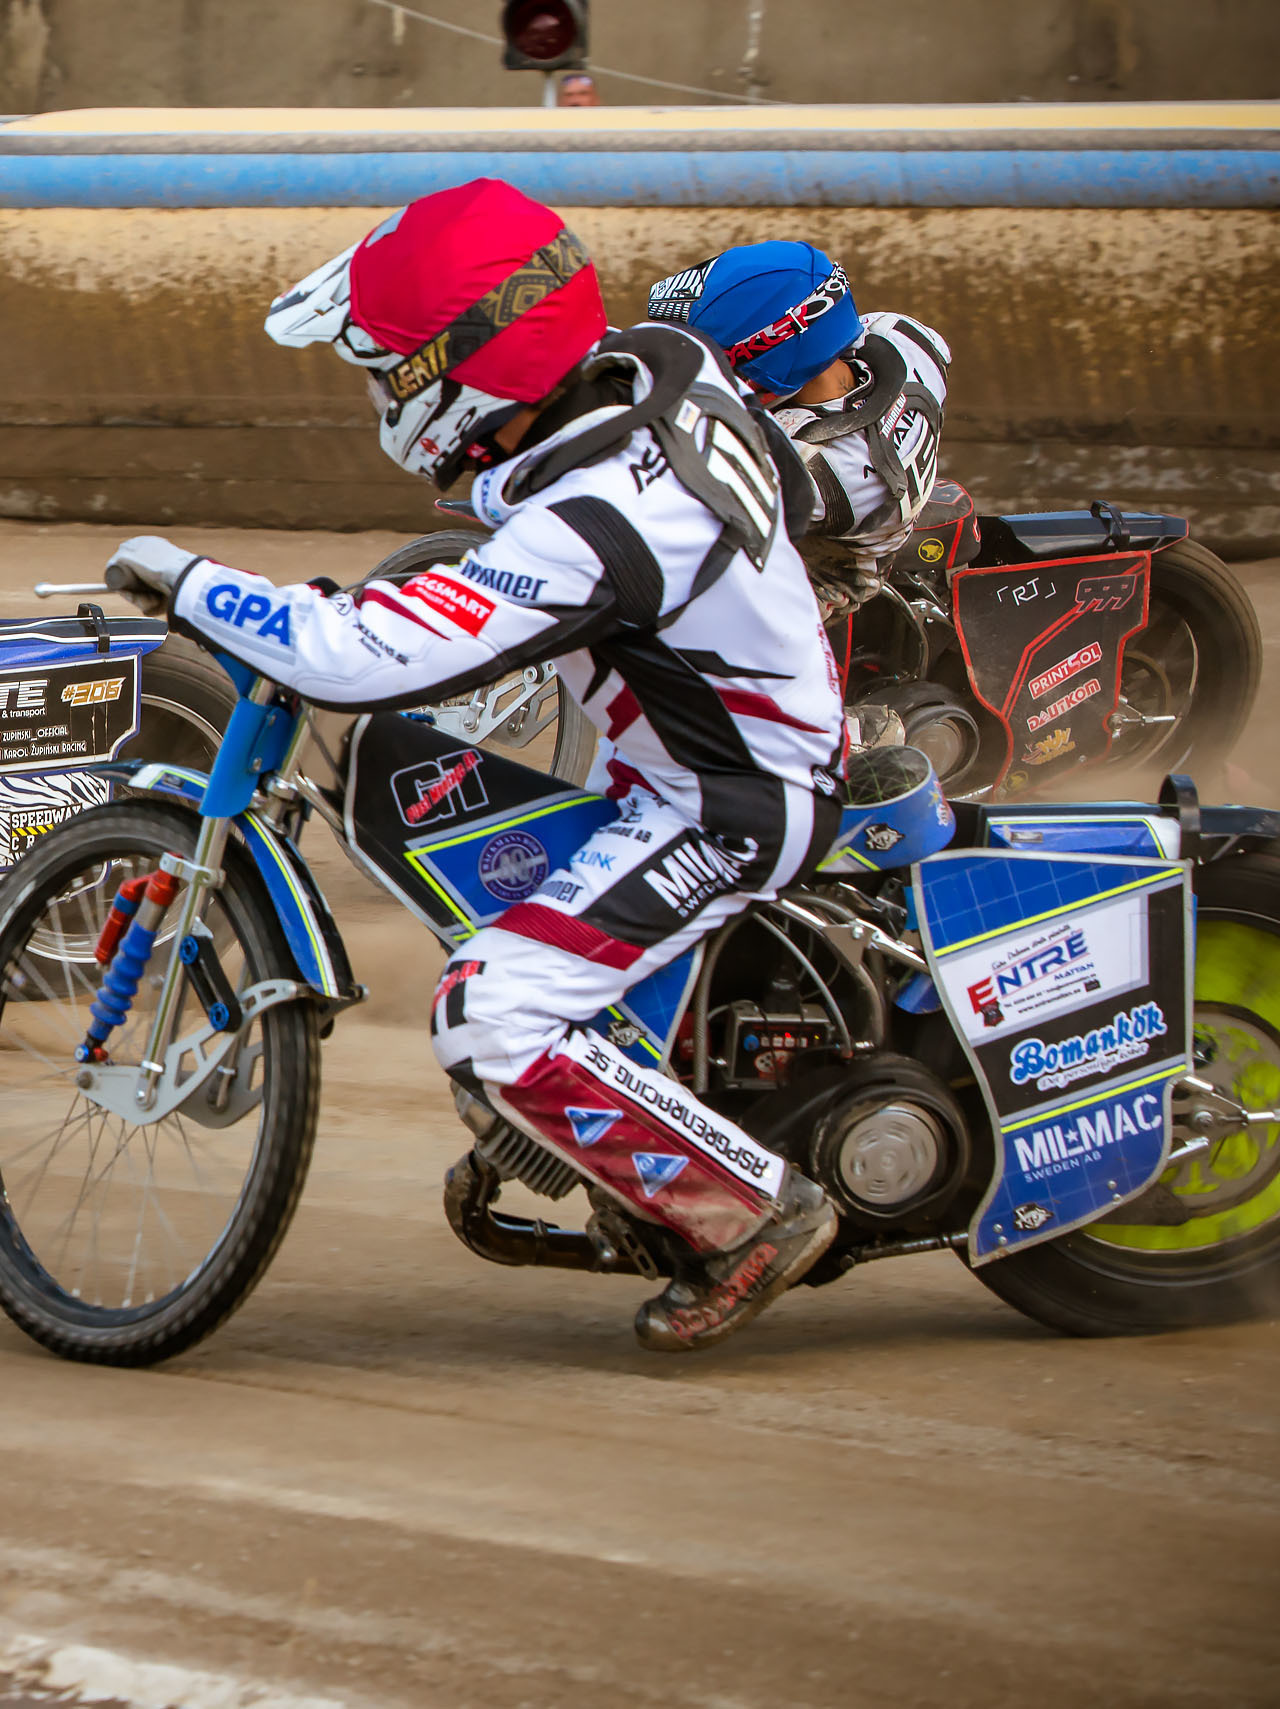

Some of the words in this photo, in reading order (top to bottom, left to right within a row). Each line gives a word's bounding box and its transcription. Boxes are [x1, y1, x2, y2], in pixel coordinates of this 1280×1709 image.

[206, 584, 292, 646] GPA
[1, 710, 8, 718] &
[10, 706, 46, 718] transport
[967, 931, 1088, 1014] ENTRE
[1013, 1003, 1166, 1083] Bomankök
[1024, 1158, 1080, 1183] SWEDEN
[1084, 1150, 1102, 1163] AB
